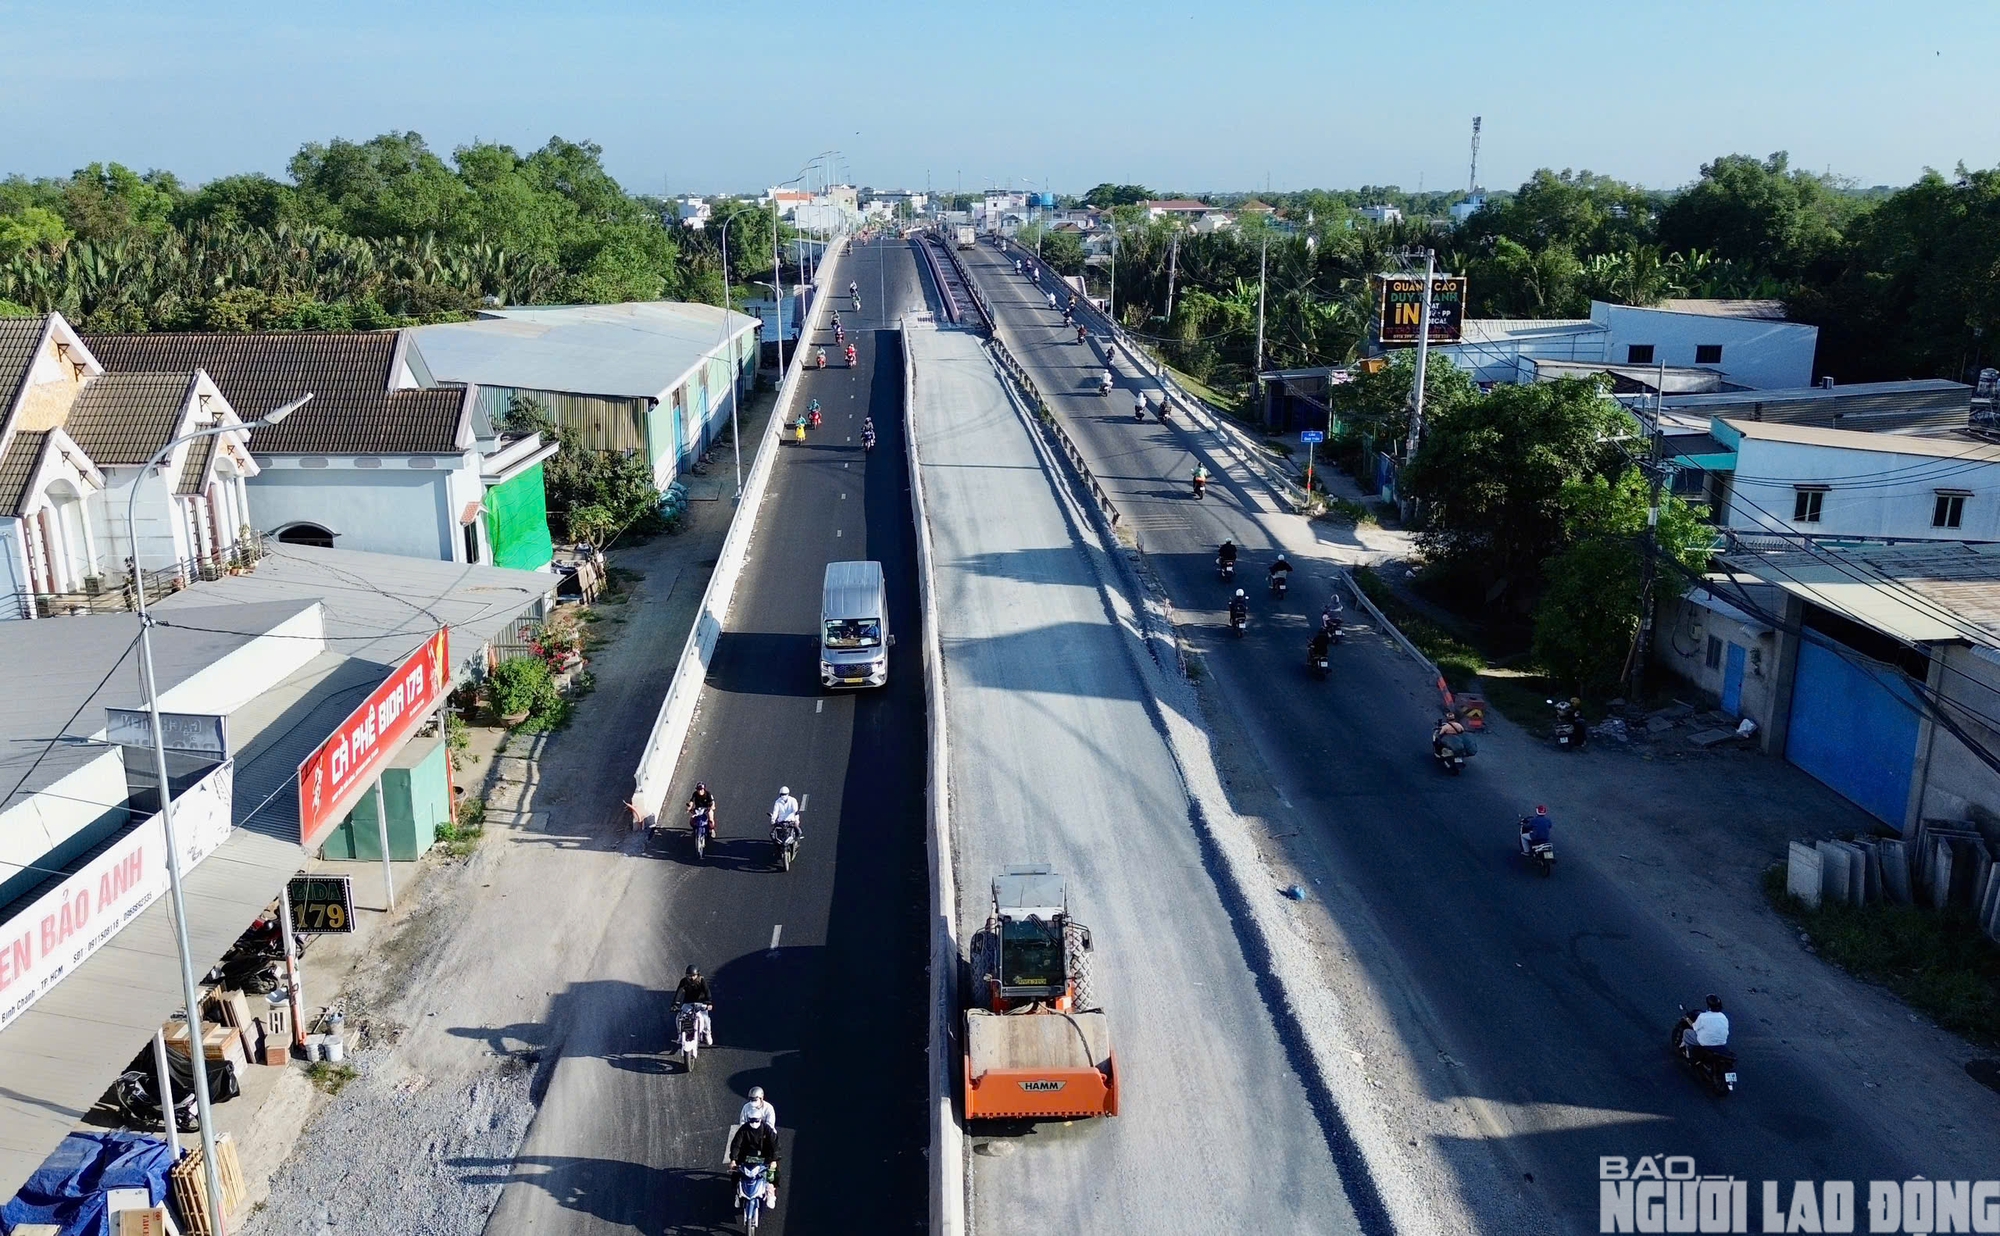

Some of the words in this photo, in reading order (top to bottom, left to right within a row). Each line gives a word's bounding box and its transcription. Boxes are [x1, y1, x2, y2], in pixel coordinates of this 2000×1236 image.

[1390, 292, 1414, 302] DUY
[331, 732, 349, 786] CÀ
[352, 703, 376, 765] PHÊ
[378, 682, 405, 736] BIDA
[405, 663, 424, 706] 179
[291, 882, 341, 900] BIDA
[41, 888, 90, 959] BẢO
[97, 846, 143, 914] ANH
[293, 903, 345, 929] 179
[50, 965, 64, 983] HCM
[1025, 1082, 1059, 1090] HAMM
